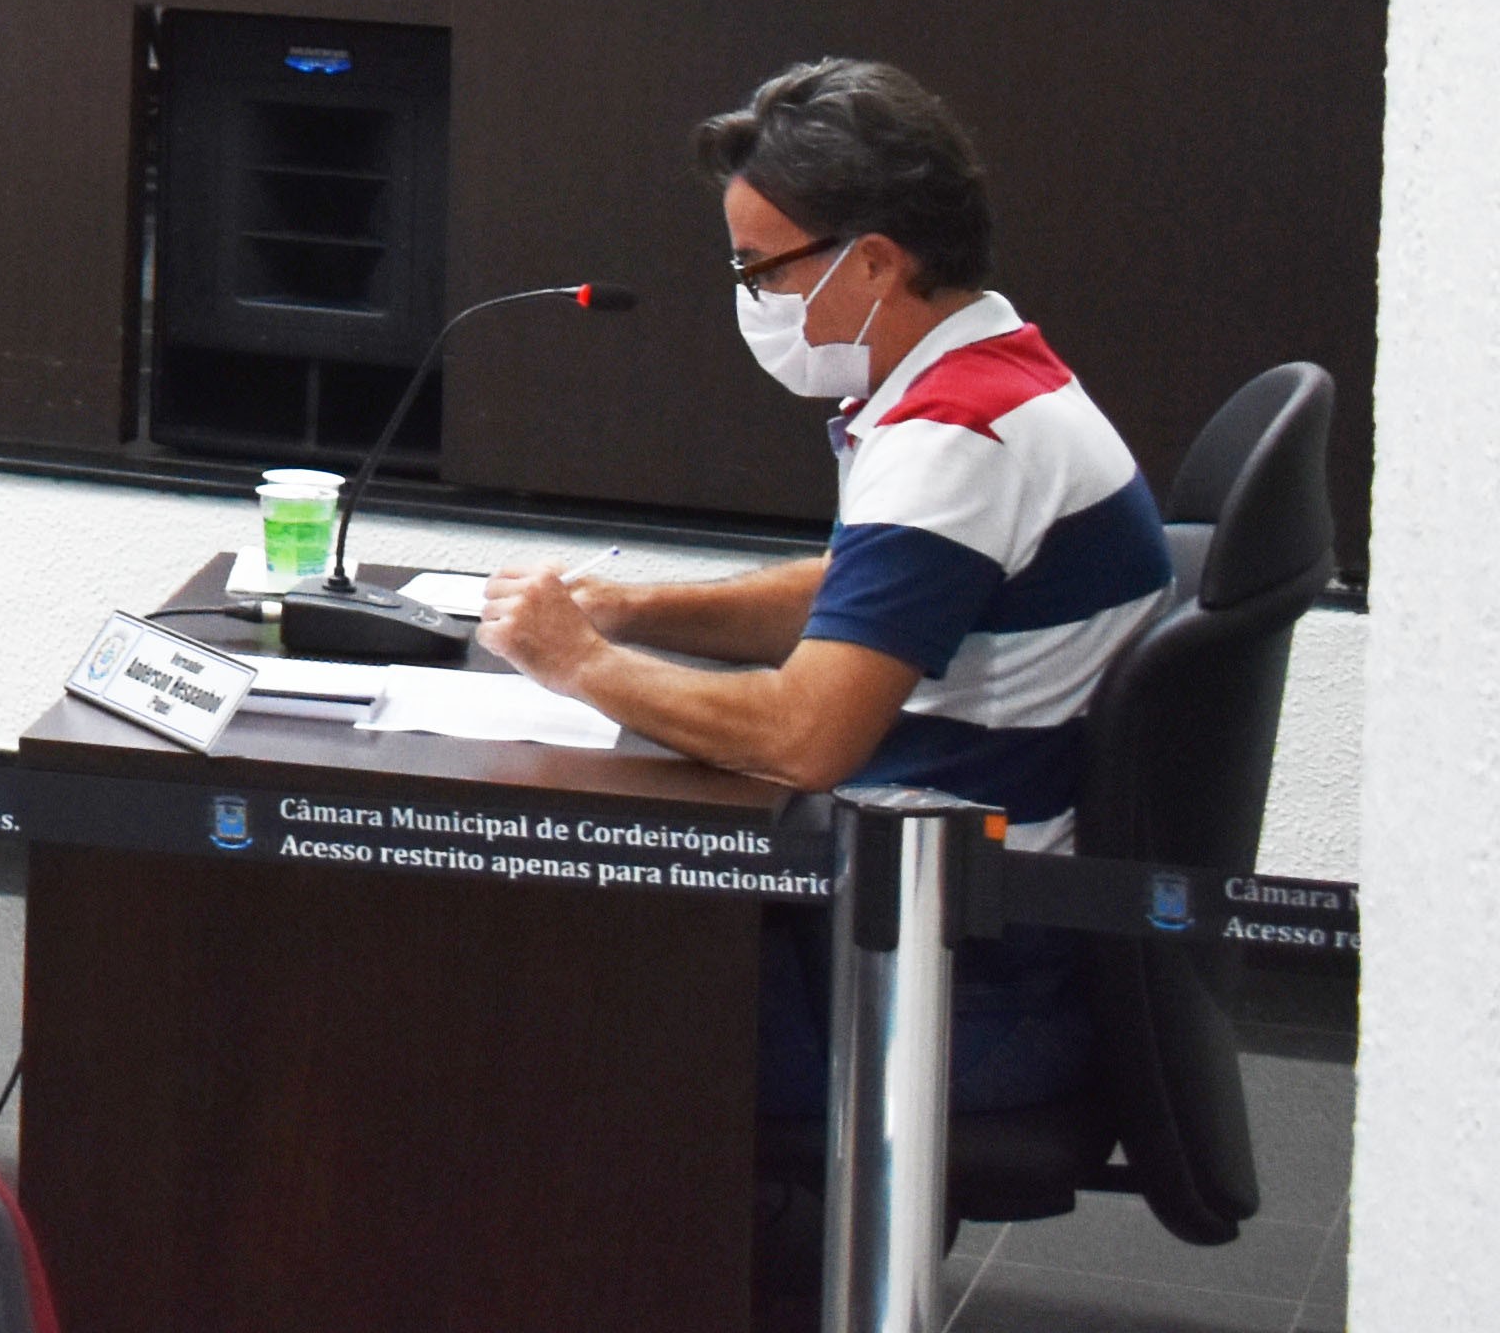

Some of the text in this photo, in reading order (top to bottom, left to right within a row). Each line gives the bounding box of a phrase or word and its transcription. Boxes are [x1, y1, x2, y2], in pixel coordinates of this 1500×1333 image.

[280, 797, 770, 857] Câmara Municipal de Cordeirópolis
[280, 835, 372, 862] Acesso
[380, 846, 484, 872] restrito
[491, 857, 590, 879] apenas
[599, 862, 662, 886] para
[1225, 876, 1340, 910] Câmara
[1223, 916, 1326, 946] Acesso
